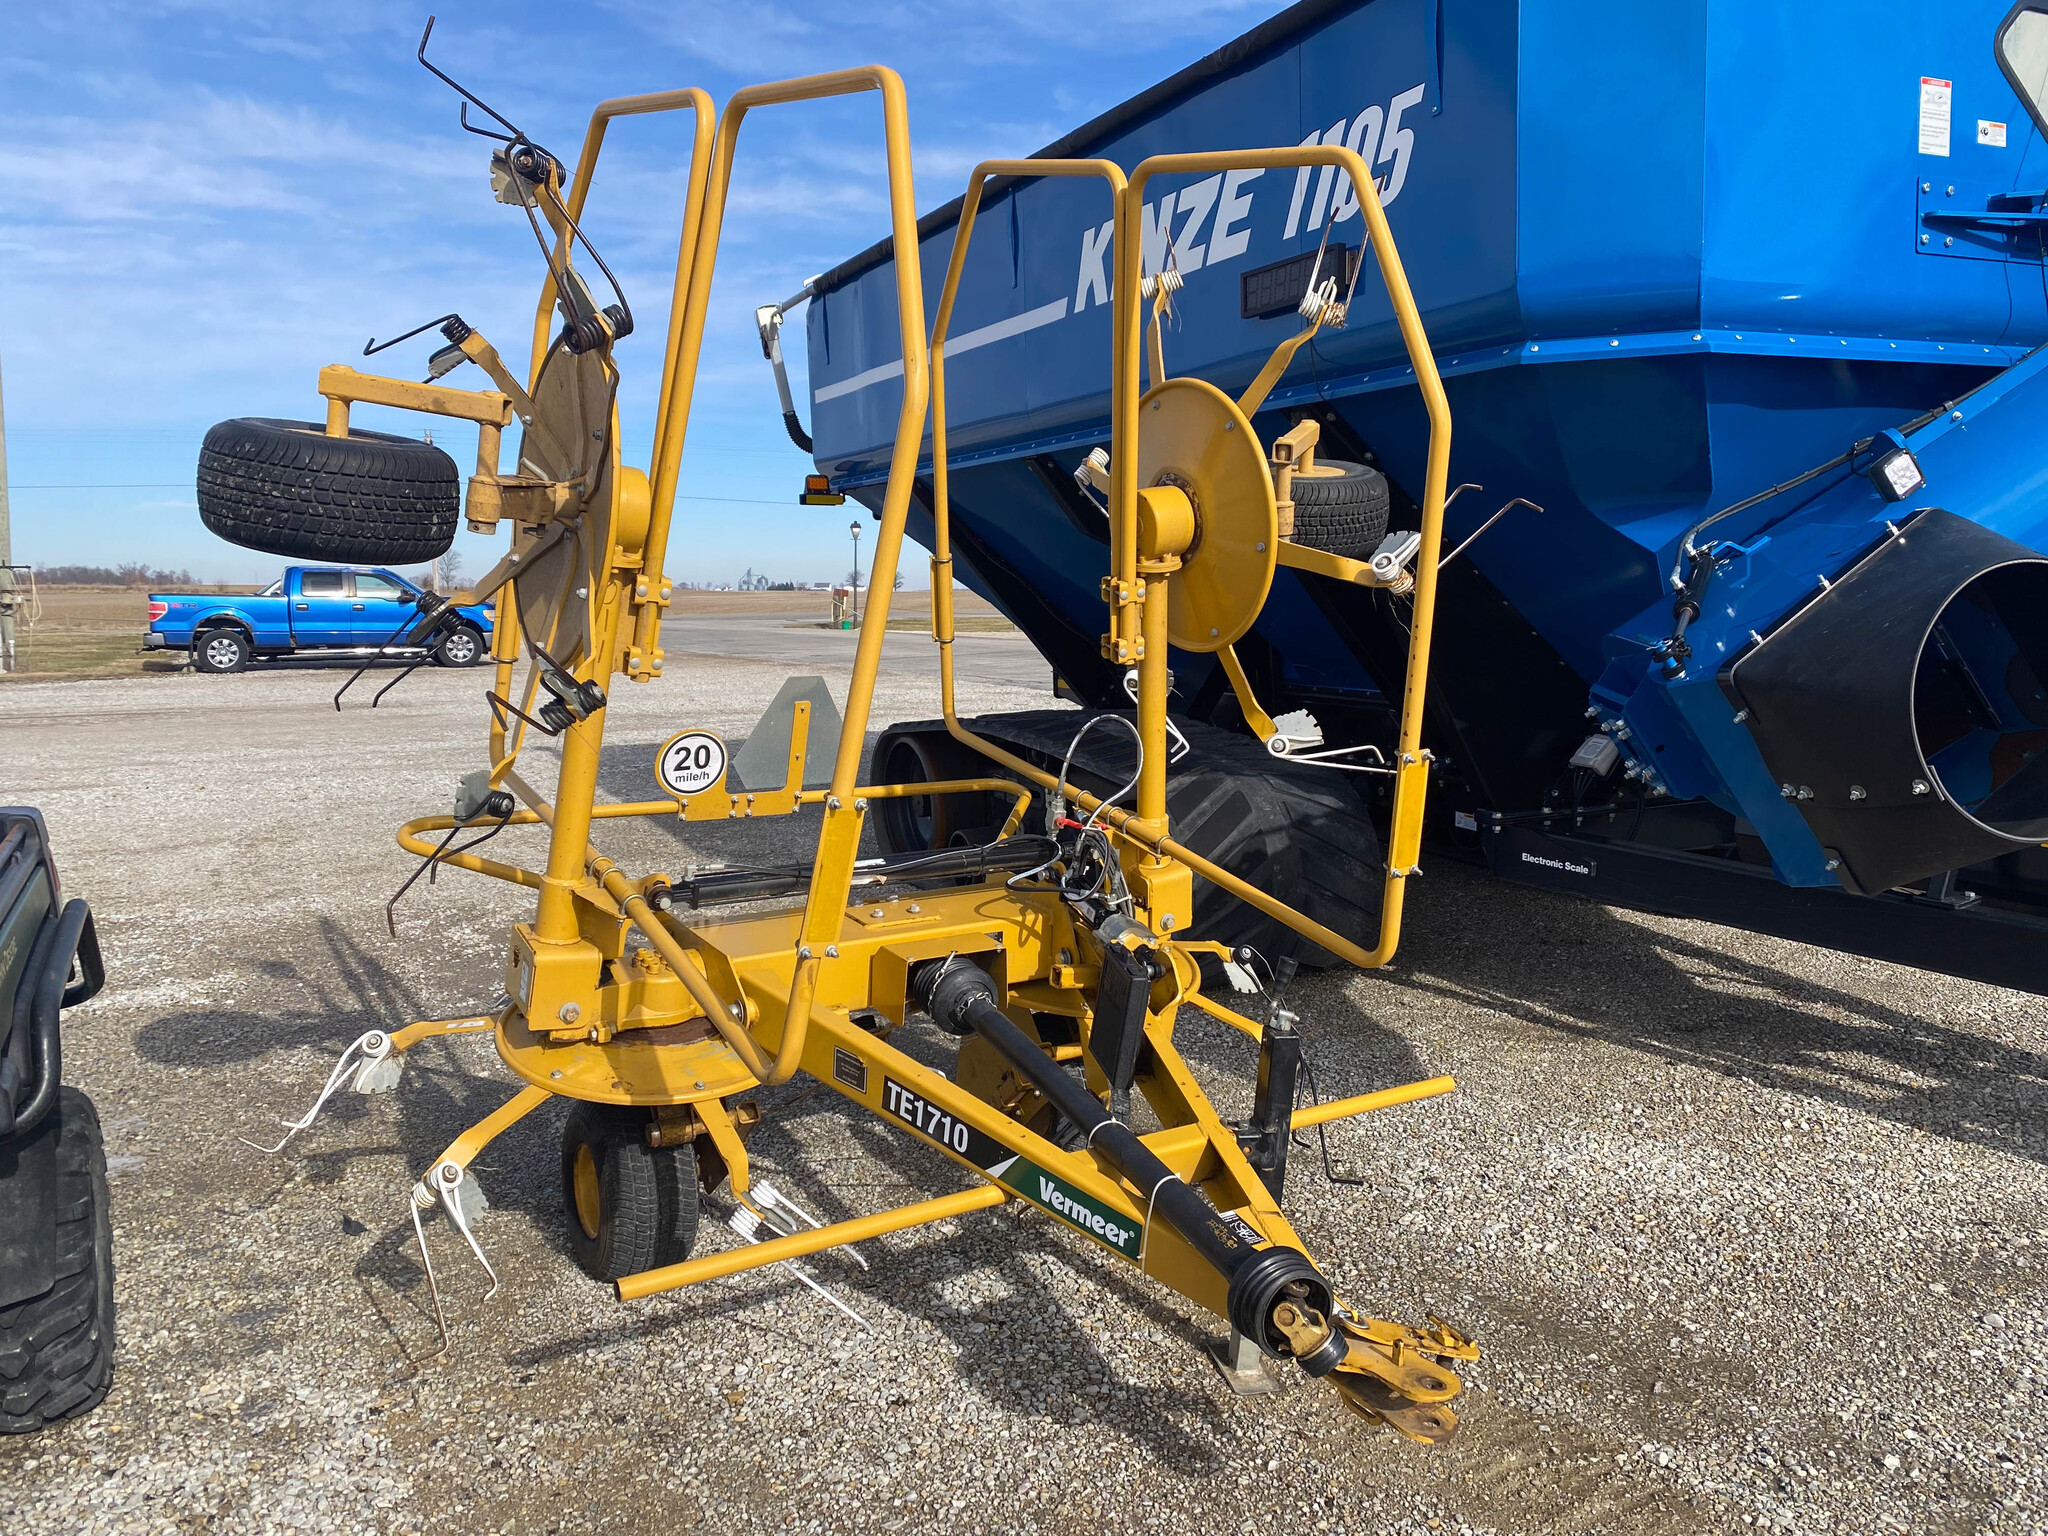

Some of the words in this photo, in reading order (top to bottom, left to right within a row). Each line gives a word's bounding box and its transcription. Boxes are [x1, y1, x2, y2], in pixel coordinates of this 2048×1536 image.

[1074, 168, 1266, 313] KNZE
[1283, 83, 1425, 239] 1105
[674, 745, 711, 771] 20
[676, 770, 709, 783] mile/h
[1522, 852, 1564, 868] Electronic
[1565, 861, 1589, 875] Scale
[887, 1081, 969, 1153] TE1710
[1039, 1175, 1130, 1248] Vermeer
